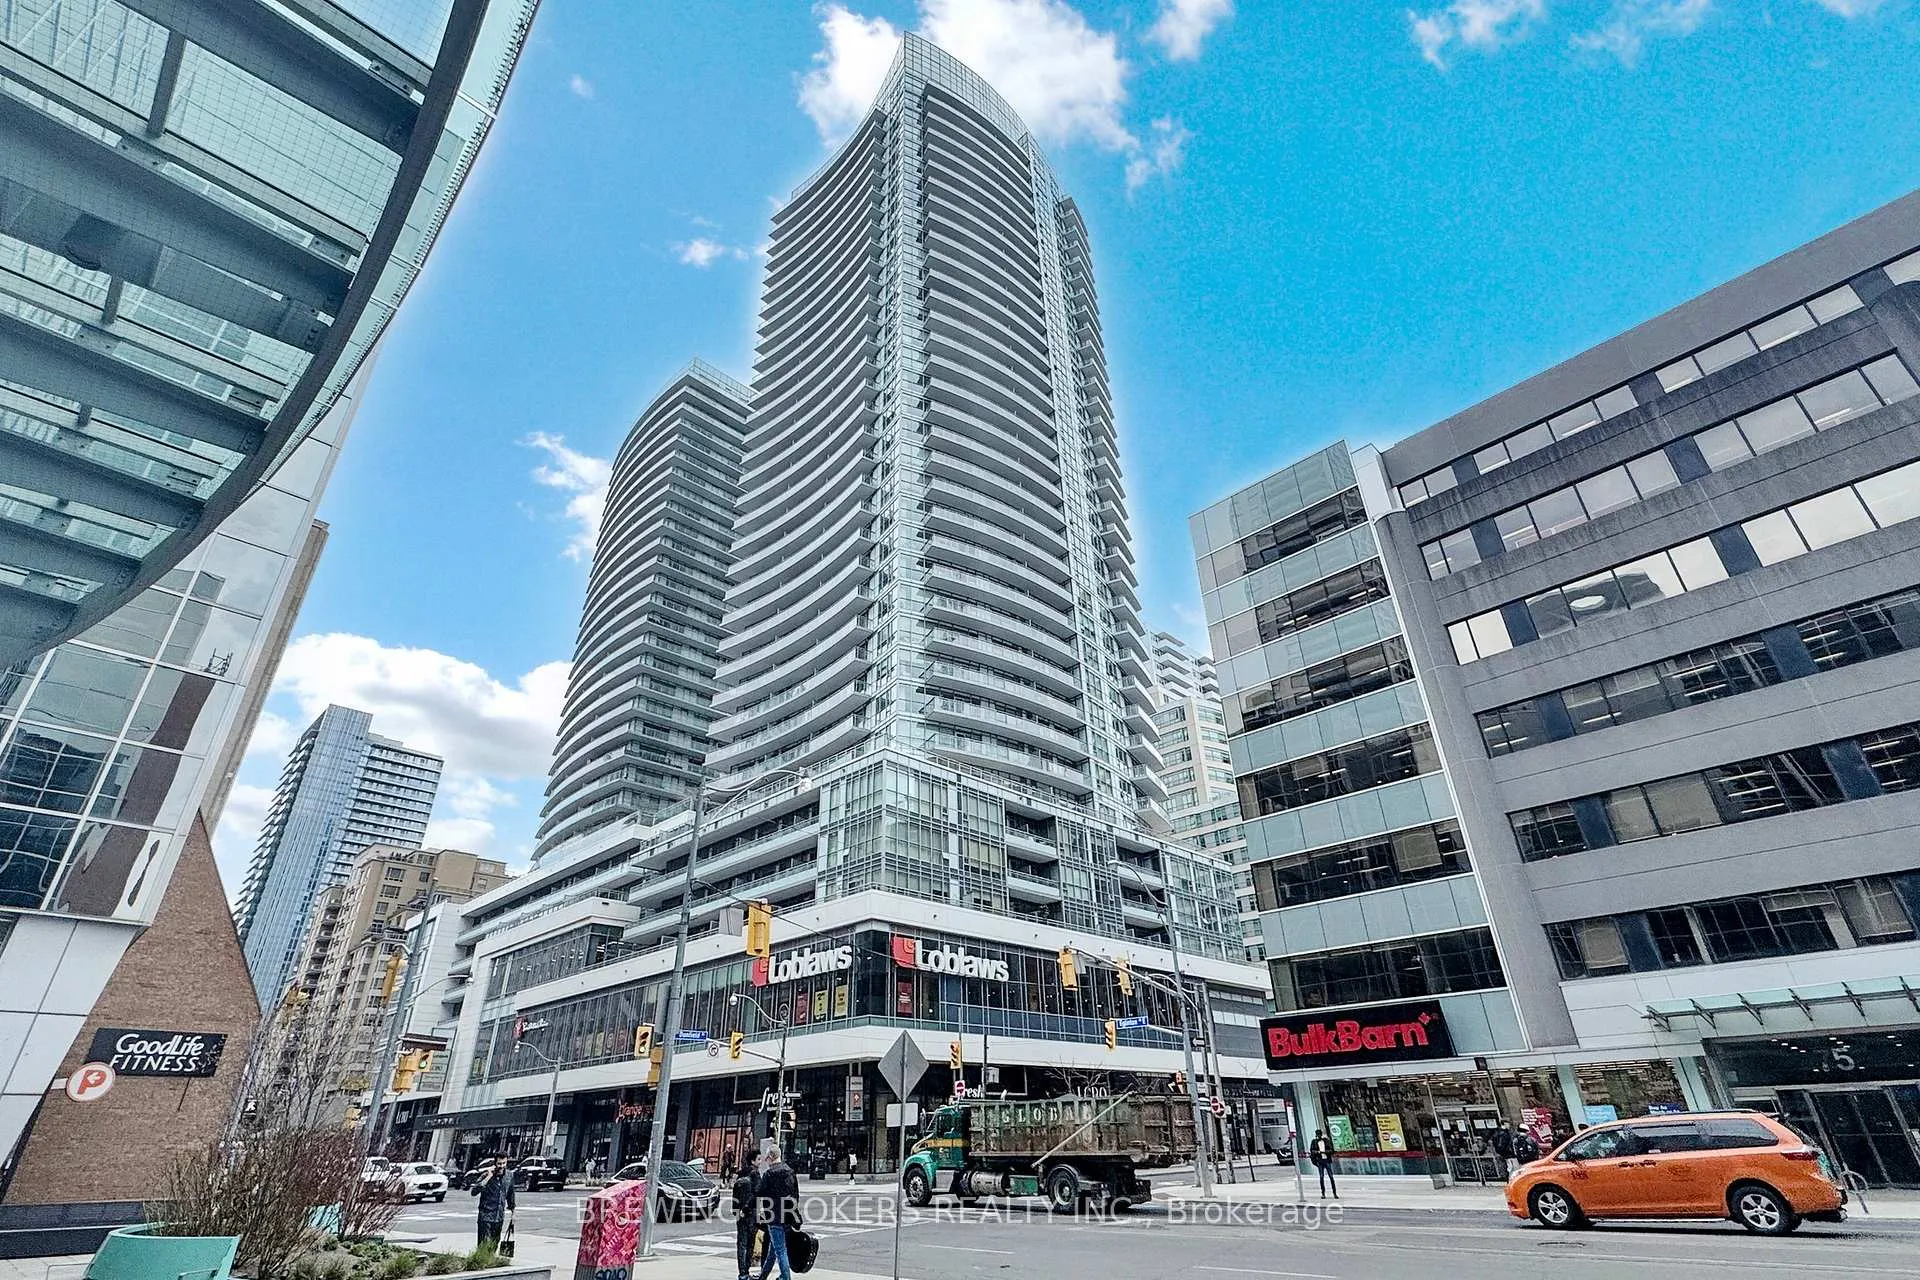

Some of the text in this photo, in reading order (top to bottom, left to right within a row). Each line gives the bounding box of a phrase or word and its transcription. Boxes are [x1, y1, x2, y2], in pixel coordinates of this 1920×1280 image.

[768, 945, 853, 984] Loblaws
[915, 939, 1010, 982] Loblaws
[115, 1033, 205, 1056] GoodLife
[1267, 1020, 1429, 1058] BulkBarn
[110, 1054, 201, 1072] FITNESS
[962, 1084, 983, 1099] resh
